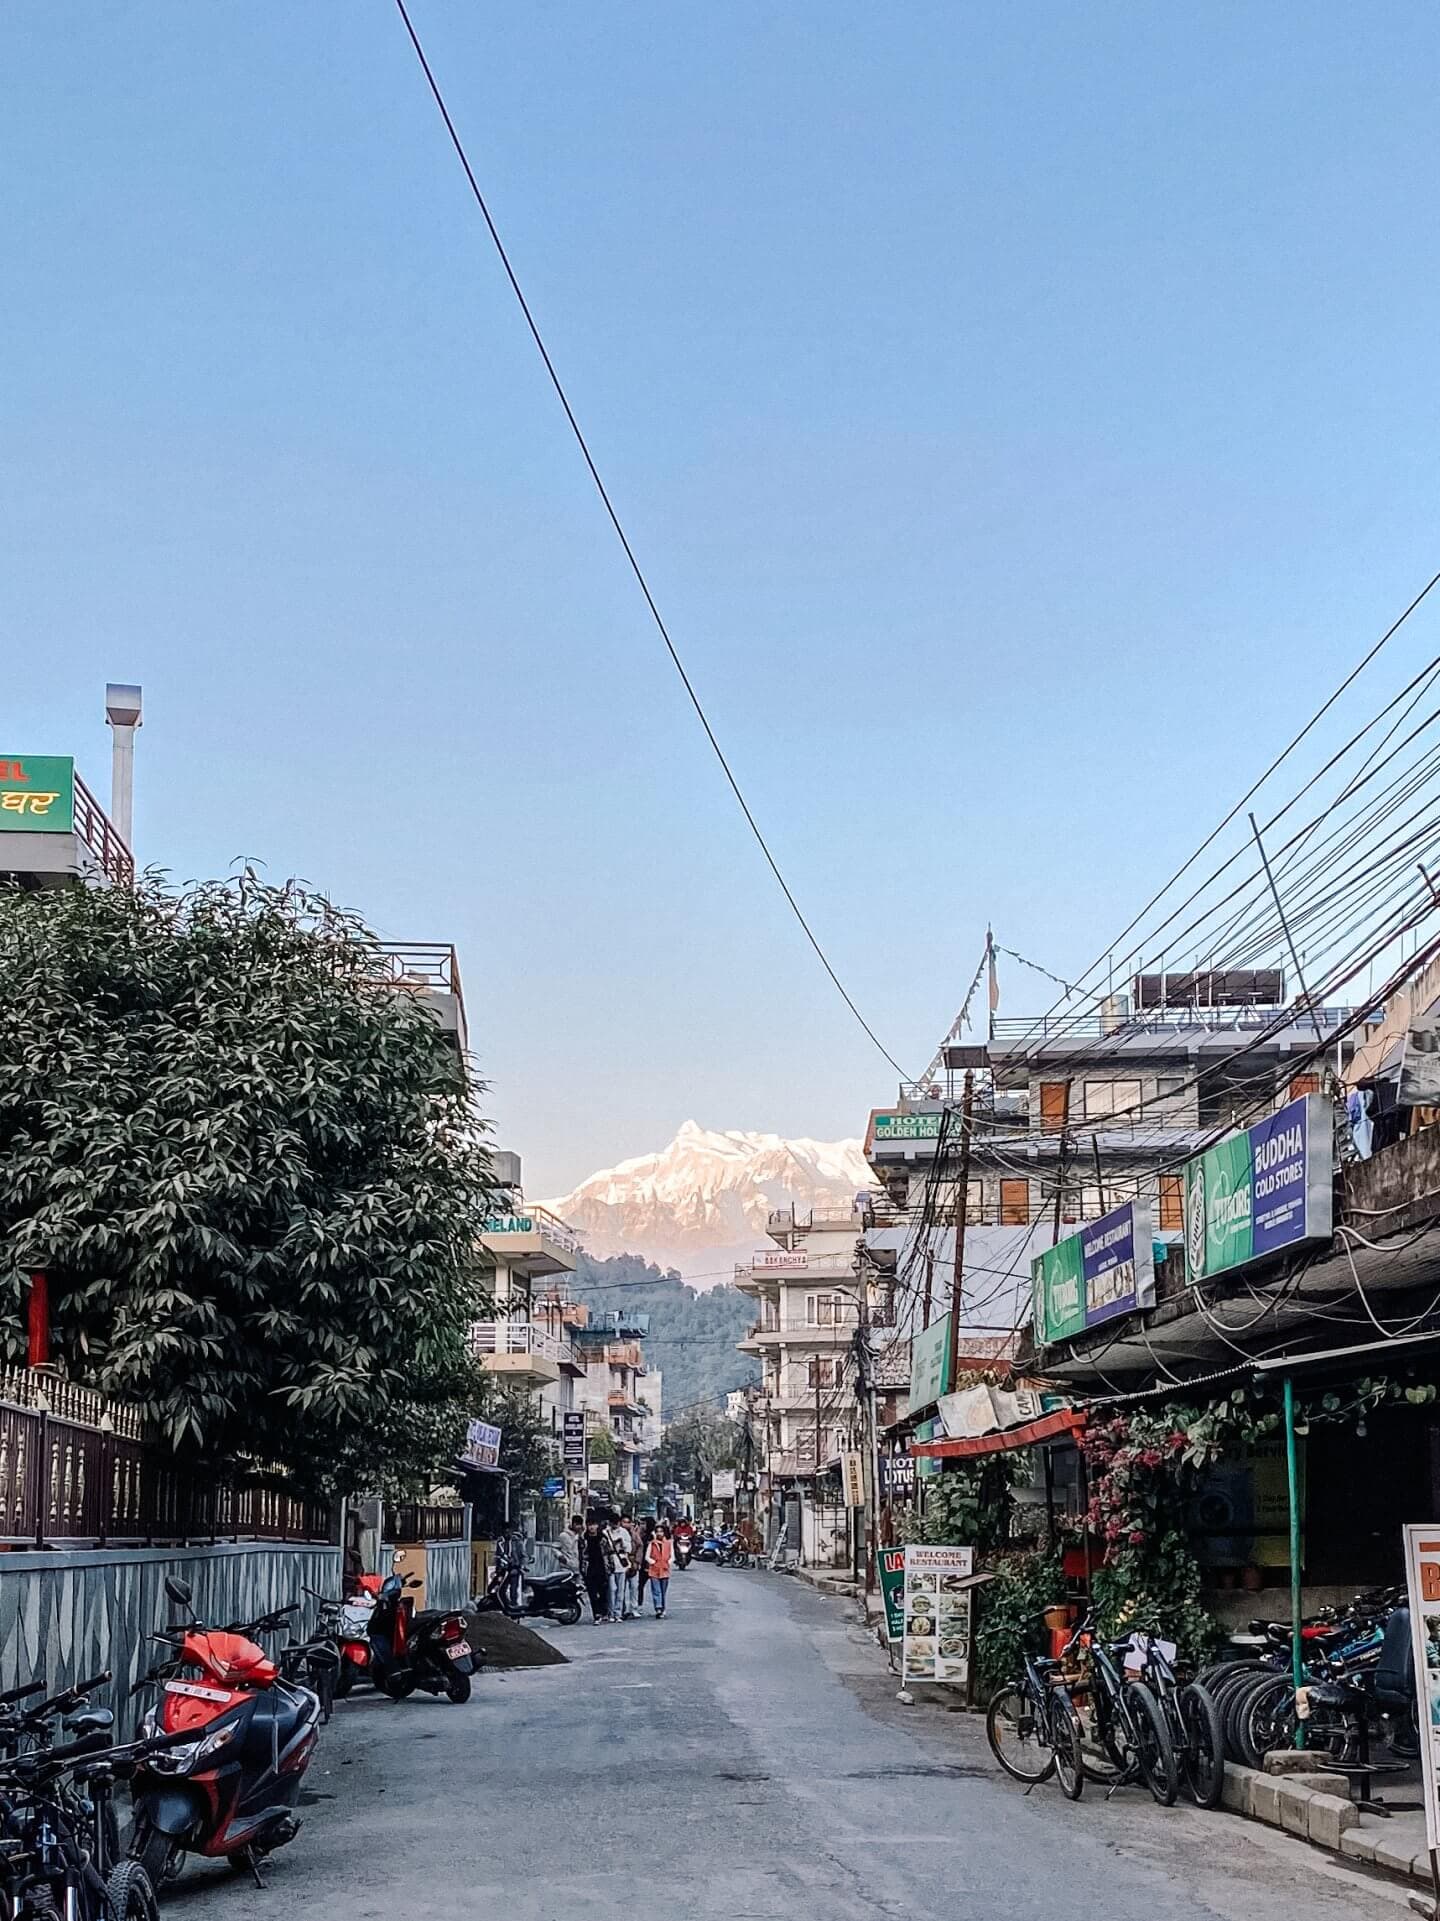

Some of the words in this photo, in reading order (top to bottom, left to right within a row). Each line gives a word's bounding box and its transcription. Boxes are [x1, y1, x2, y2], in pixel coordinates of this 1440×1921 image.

[876, 1127, 917, 1138] GOLDEN
[1255, 1123, 1304, 1175] BUDDHA
[1255, 1170, 1275, 1200] COLD
[1274, 1160, 1304, 1190] STORES
[1215, 1183, 1251, 1230] TUBORG
[909, 1557, 969, 1569] RESTAURANT
[915, 1550, 963, 1560] WELCOME
